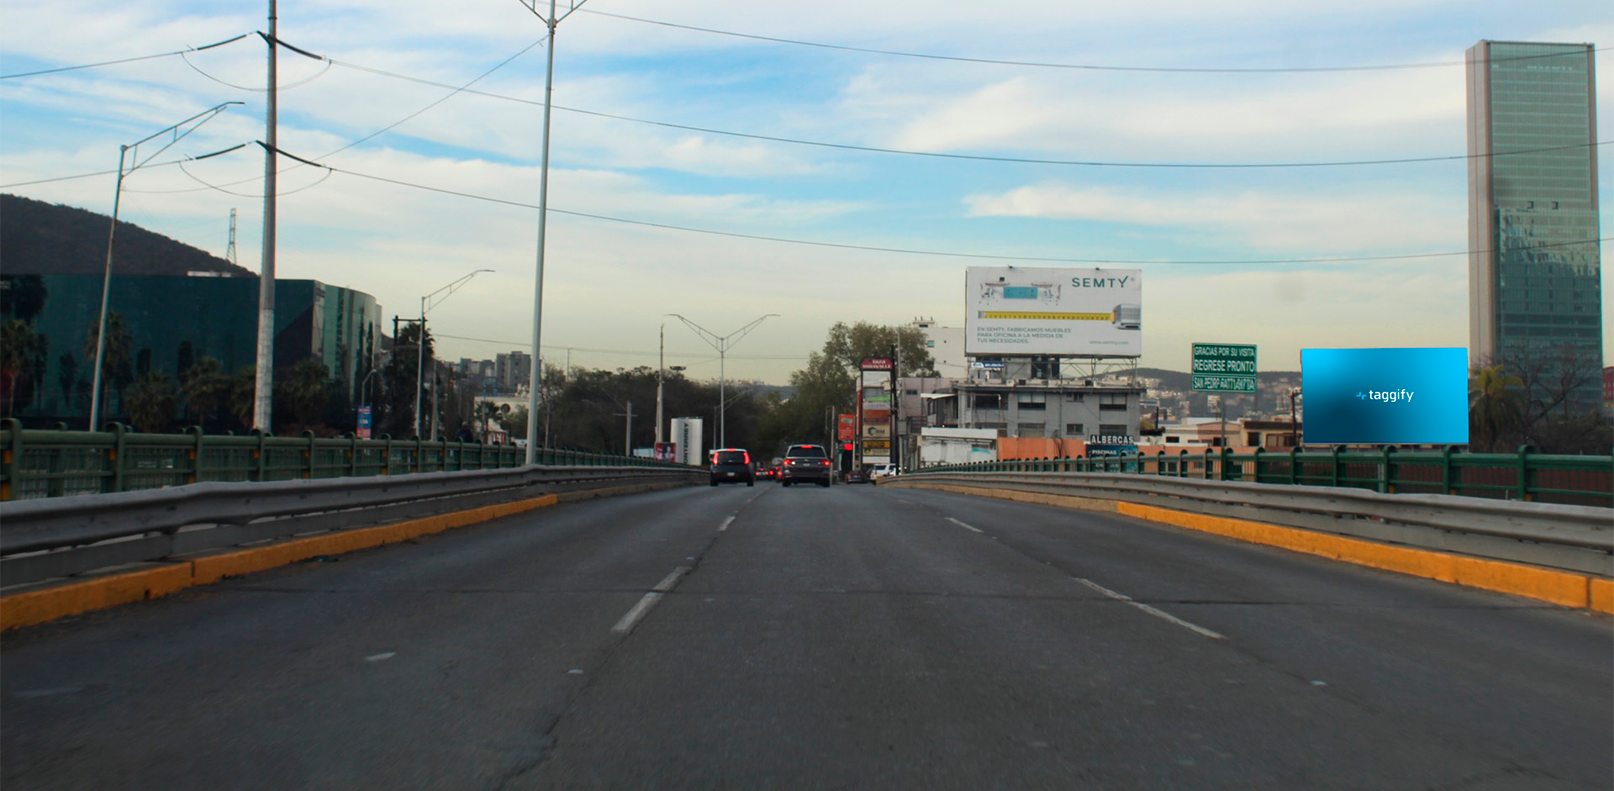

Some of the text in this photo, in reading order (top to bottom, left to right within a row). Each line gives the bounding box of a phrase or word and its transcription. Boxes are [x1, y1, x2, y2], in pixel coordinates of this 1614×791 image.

[1072, 276, 1129, 288] SEMTY
[1194, 346, 1255, 357] GRACIAS POR SU VISITA
[1194, 359, 1255, 372] REGRESE PRONTO
[1369, 389, 1414, 403] taggify
[1091, 435, 1134, 444] ALBERCAS
